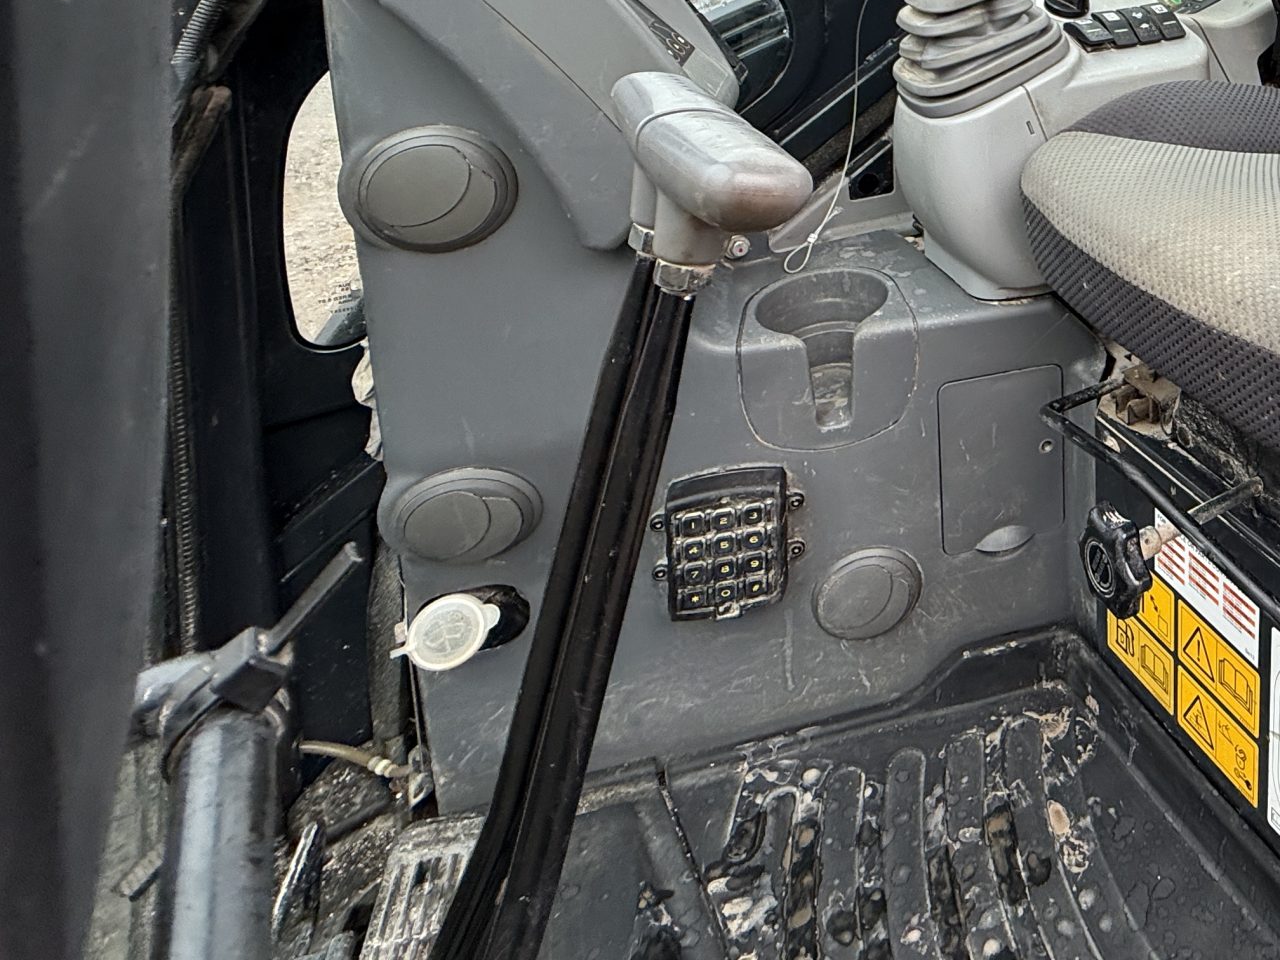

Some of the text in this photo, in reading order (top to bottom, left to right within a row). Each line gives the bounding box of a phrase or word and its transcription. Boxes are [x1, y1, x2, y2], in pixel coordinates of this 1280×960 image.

[719, 517, 728, 525] 2
[749, 511, 758, 519] 3
[688, 535, 758, 554] 4 5 6
[691, 559, 760, 579] 7 8 9
